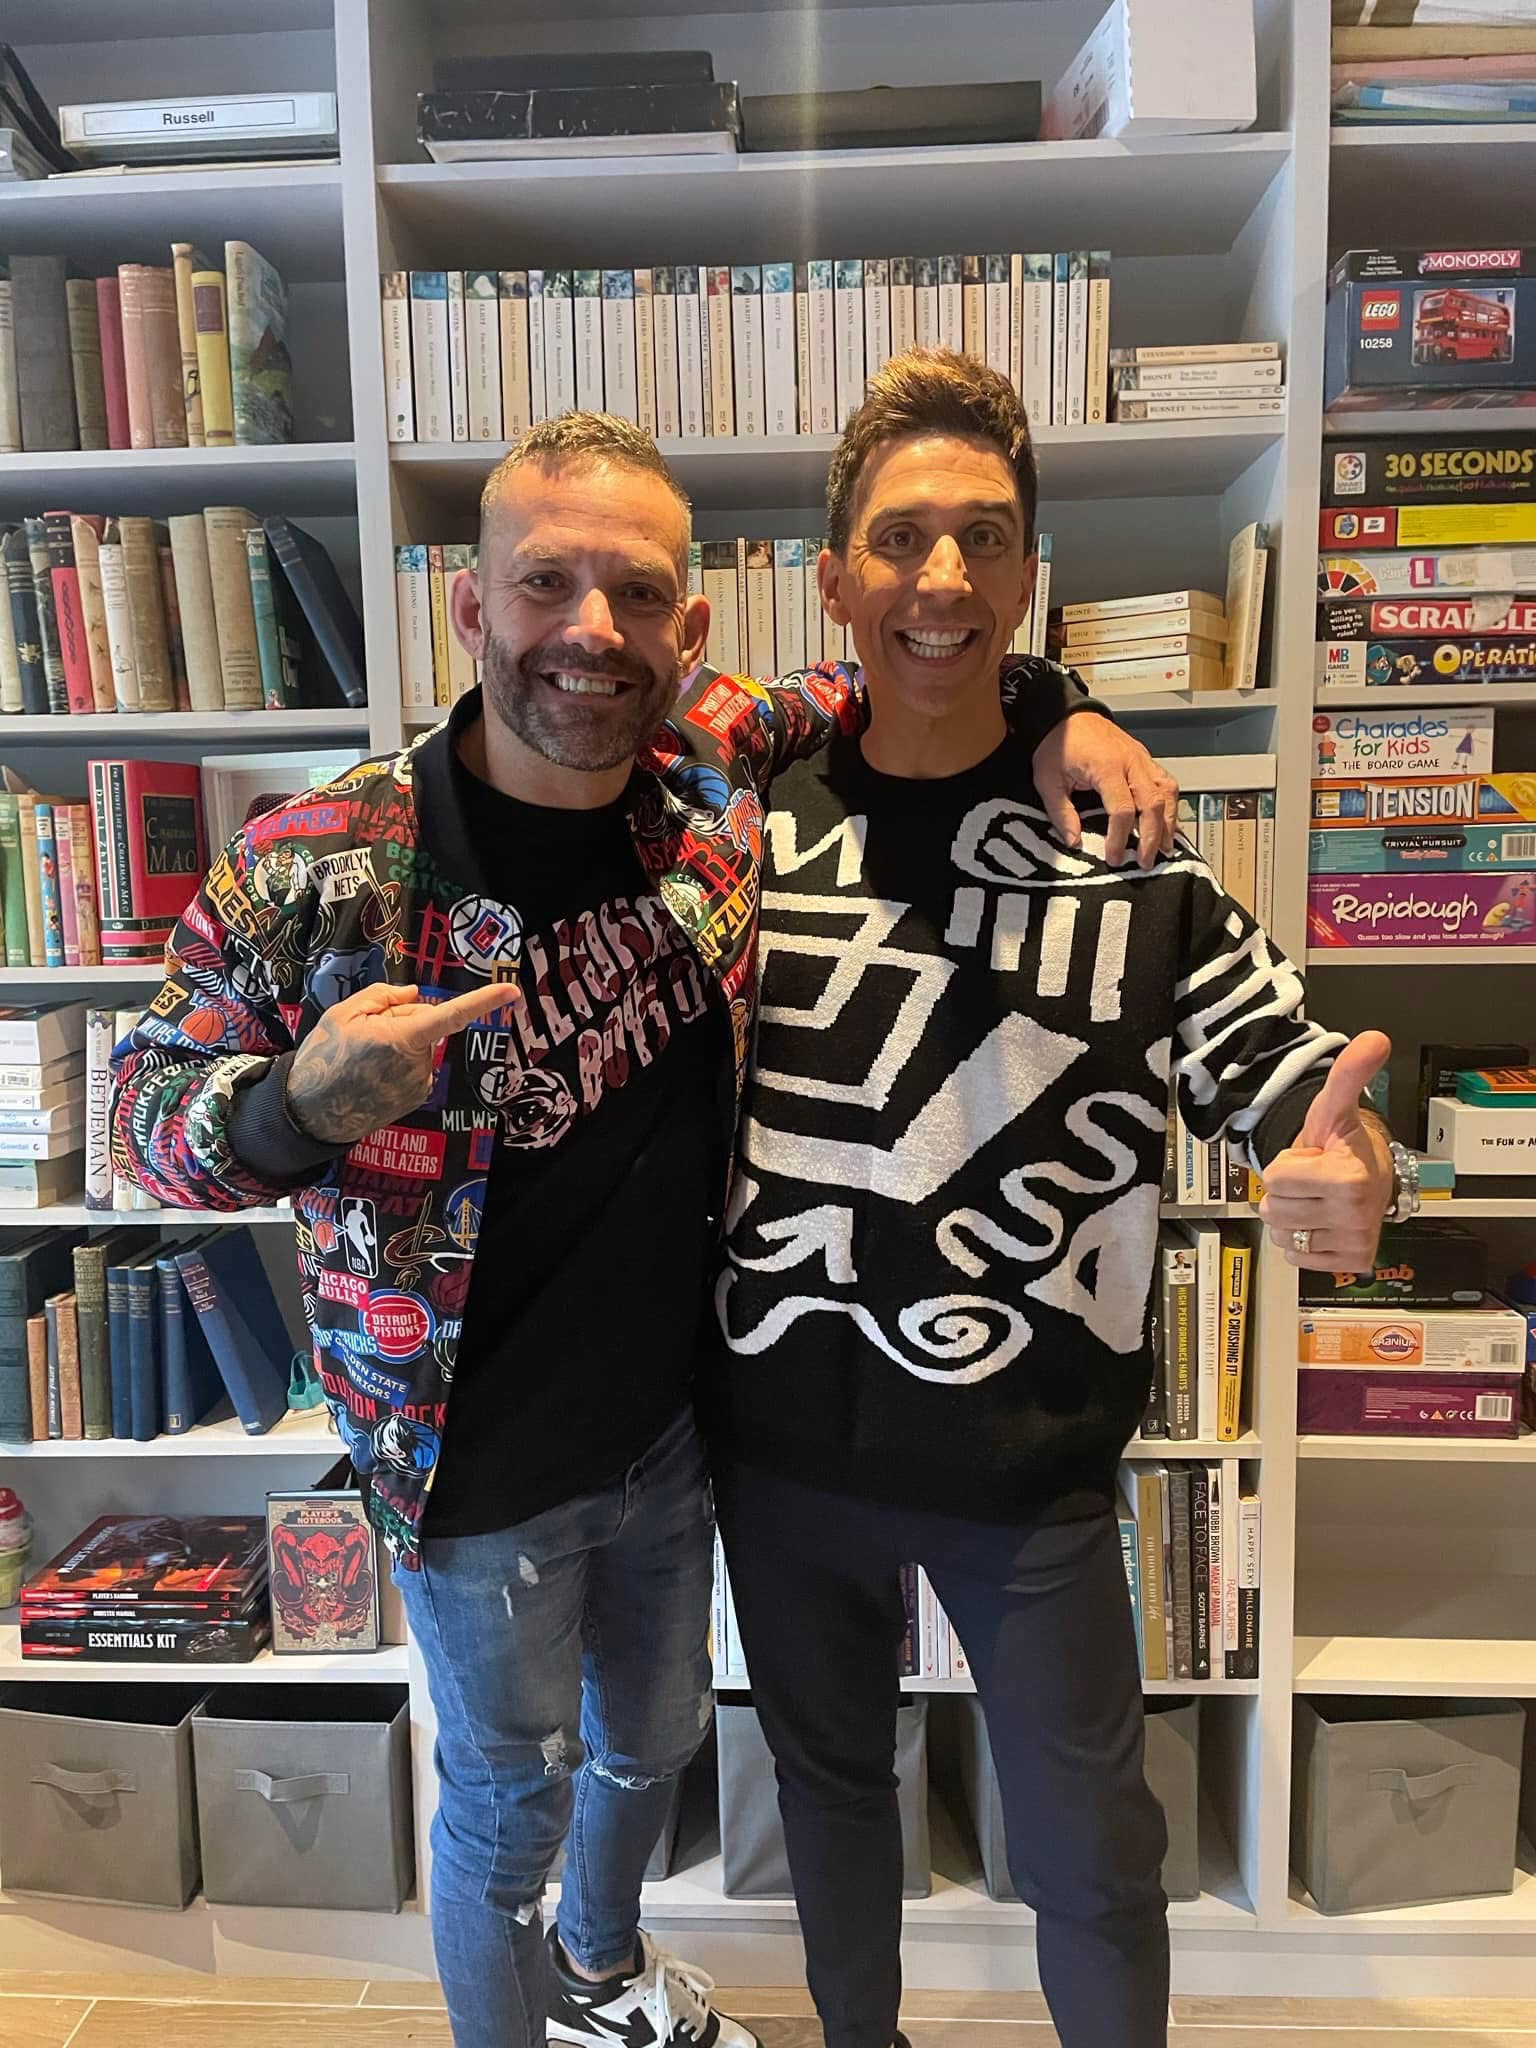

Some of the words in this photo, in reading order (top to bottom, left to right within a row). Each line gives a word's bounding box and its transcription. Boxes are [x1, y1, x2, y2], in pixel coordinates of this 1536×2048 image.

[162, 110, 215, 126] Russell
[1429, 253, 1518, 268] MONOPOLY
[1364, 303, 1398, 318] LEGO
[1360, 339, 1393, 350] 10258
[1384, 453, 1416, 479] 30
[1420, 449, 1534, 477] SECONDS
[1378, 604, 1536, 631] SCRALE
[1328, 648, 1351, 664] MB
[1433, 642, 1536, 675] OPERATI
[1335, 714, 1449, 740] Charades
[1352, 738, 1383, 758] for
[1386, 736, 1432, 757] Kids
[1342, 760, 1361, 771] THE
[1367, 759, 1405, 771] BOARD
[1408, 758, 1441, 770] GAME
[1366, 782, 1474, 821] TENSION
[1384, 839, 1421, 849] TRIVIAL
[1421, 838, 1462, 848] PURSUIT
[116, 841, 128, 888] CHAIRMAN
[149, 845, 198, 874] MAO
[334, 876, 361, 898] NETS
[120, 888, 129, 913] MAO
[1331, 891, 1479, 932] Rapidough
[90, 1069, 108, 1178] BETJEMAN
[1496, 1137, 1514, 1147] FUN
[383, 1149, 438, 1174] BLAZERS
[351, 1256, 367, 1272] NBA
[371, 1312, 419, 1327] DETROIT
[373, 1324, 421, 1338] PISTONS
[1177, 1306, 1189, 1362] PERFORMANCE
[1226, 1318, 1241, 1364] CRUSHING
[1225, 1363, 1239, 1377] IT!
[370, 1372, 407, 1394] STATE
[1193, 1481, 1208, 1520] FACE
[301, 1510, 339, 1518] PLAYER'S
[1210, 1509, 1220, 1534] BOBBI
[1194, 1521, 1209, 1544] TO
[1246, 1526, 1256, 1560] HAPPY
[1210, 1535, 1220, 1564] BROWN
[1195, 1545, 1209, 1585] FACE
[1245, 1561, 1256, 1587] SEXY
[1225, 1578, 1237, 1601] RAE
[1197, 1591, 1206, 1617] SCOTT
[1225, 1600, 1237, 1641] MORRIS
[1244, 1590, 1255, 1650] MILLIONAIRE
[87, 1631, 155, 1649] ESSENTIALS
[156, 1632, 178, 1649] KIT
[1198, 1617, 1207, 1650] BARNES
